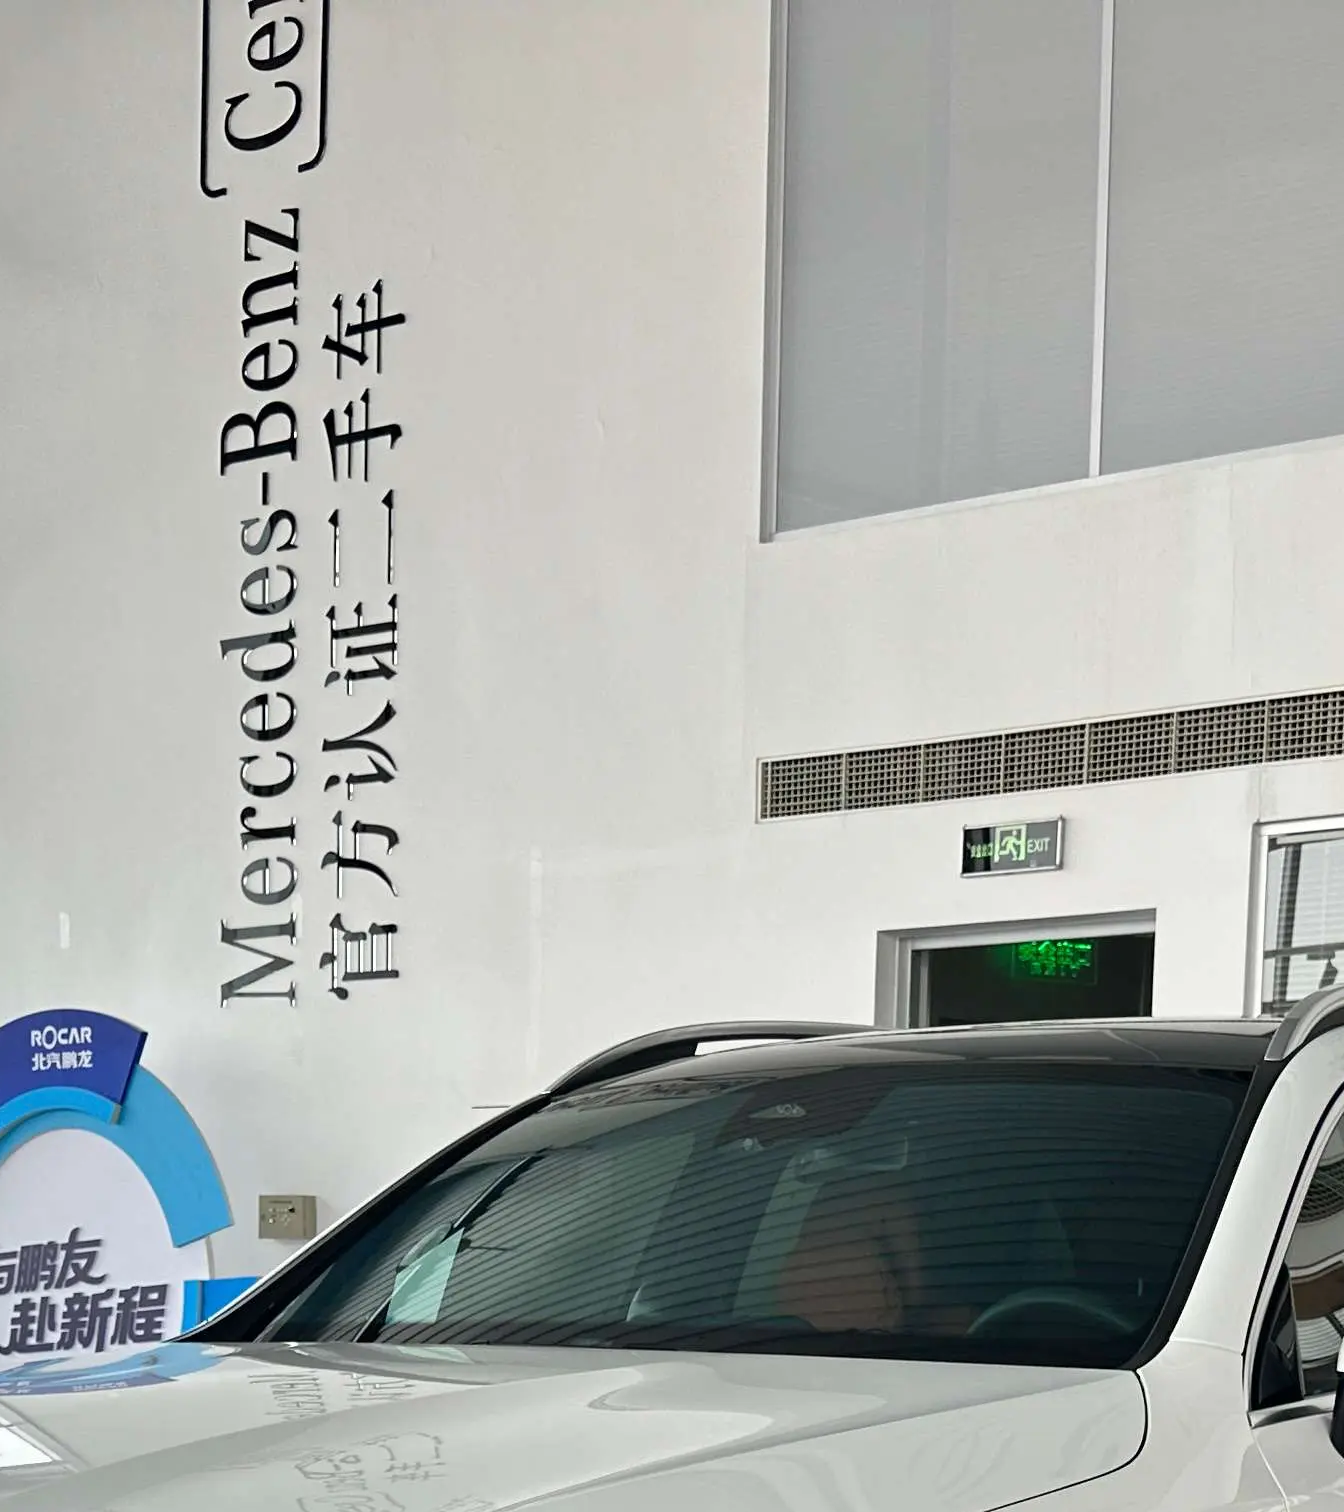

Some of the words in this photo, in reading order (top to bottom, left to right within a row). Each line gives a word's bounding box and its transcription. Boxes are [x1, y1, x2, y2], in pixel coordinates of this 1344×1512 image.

[220, 207, 300, 1009] Mercedes-Benz
[319, 278, 407, 1001] 官方认证二手车
[1027, 837, 1051, 853] EXIT
[30, 1025, 93, 1050] ROCAR
[31, 1050, 93, 1071] 北汽鹏龙
